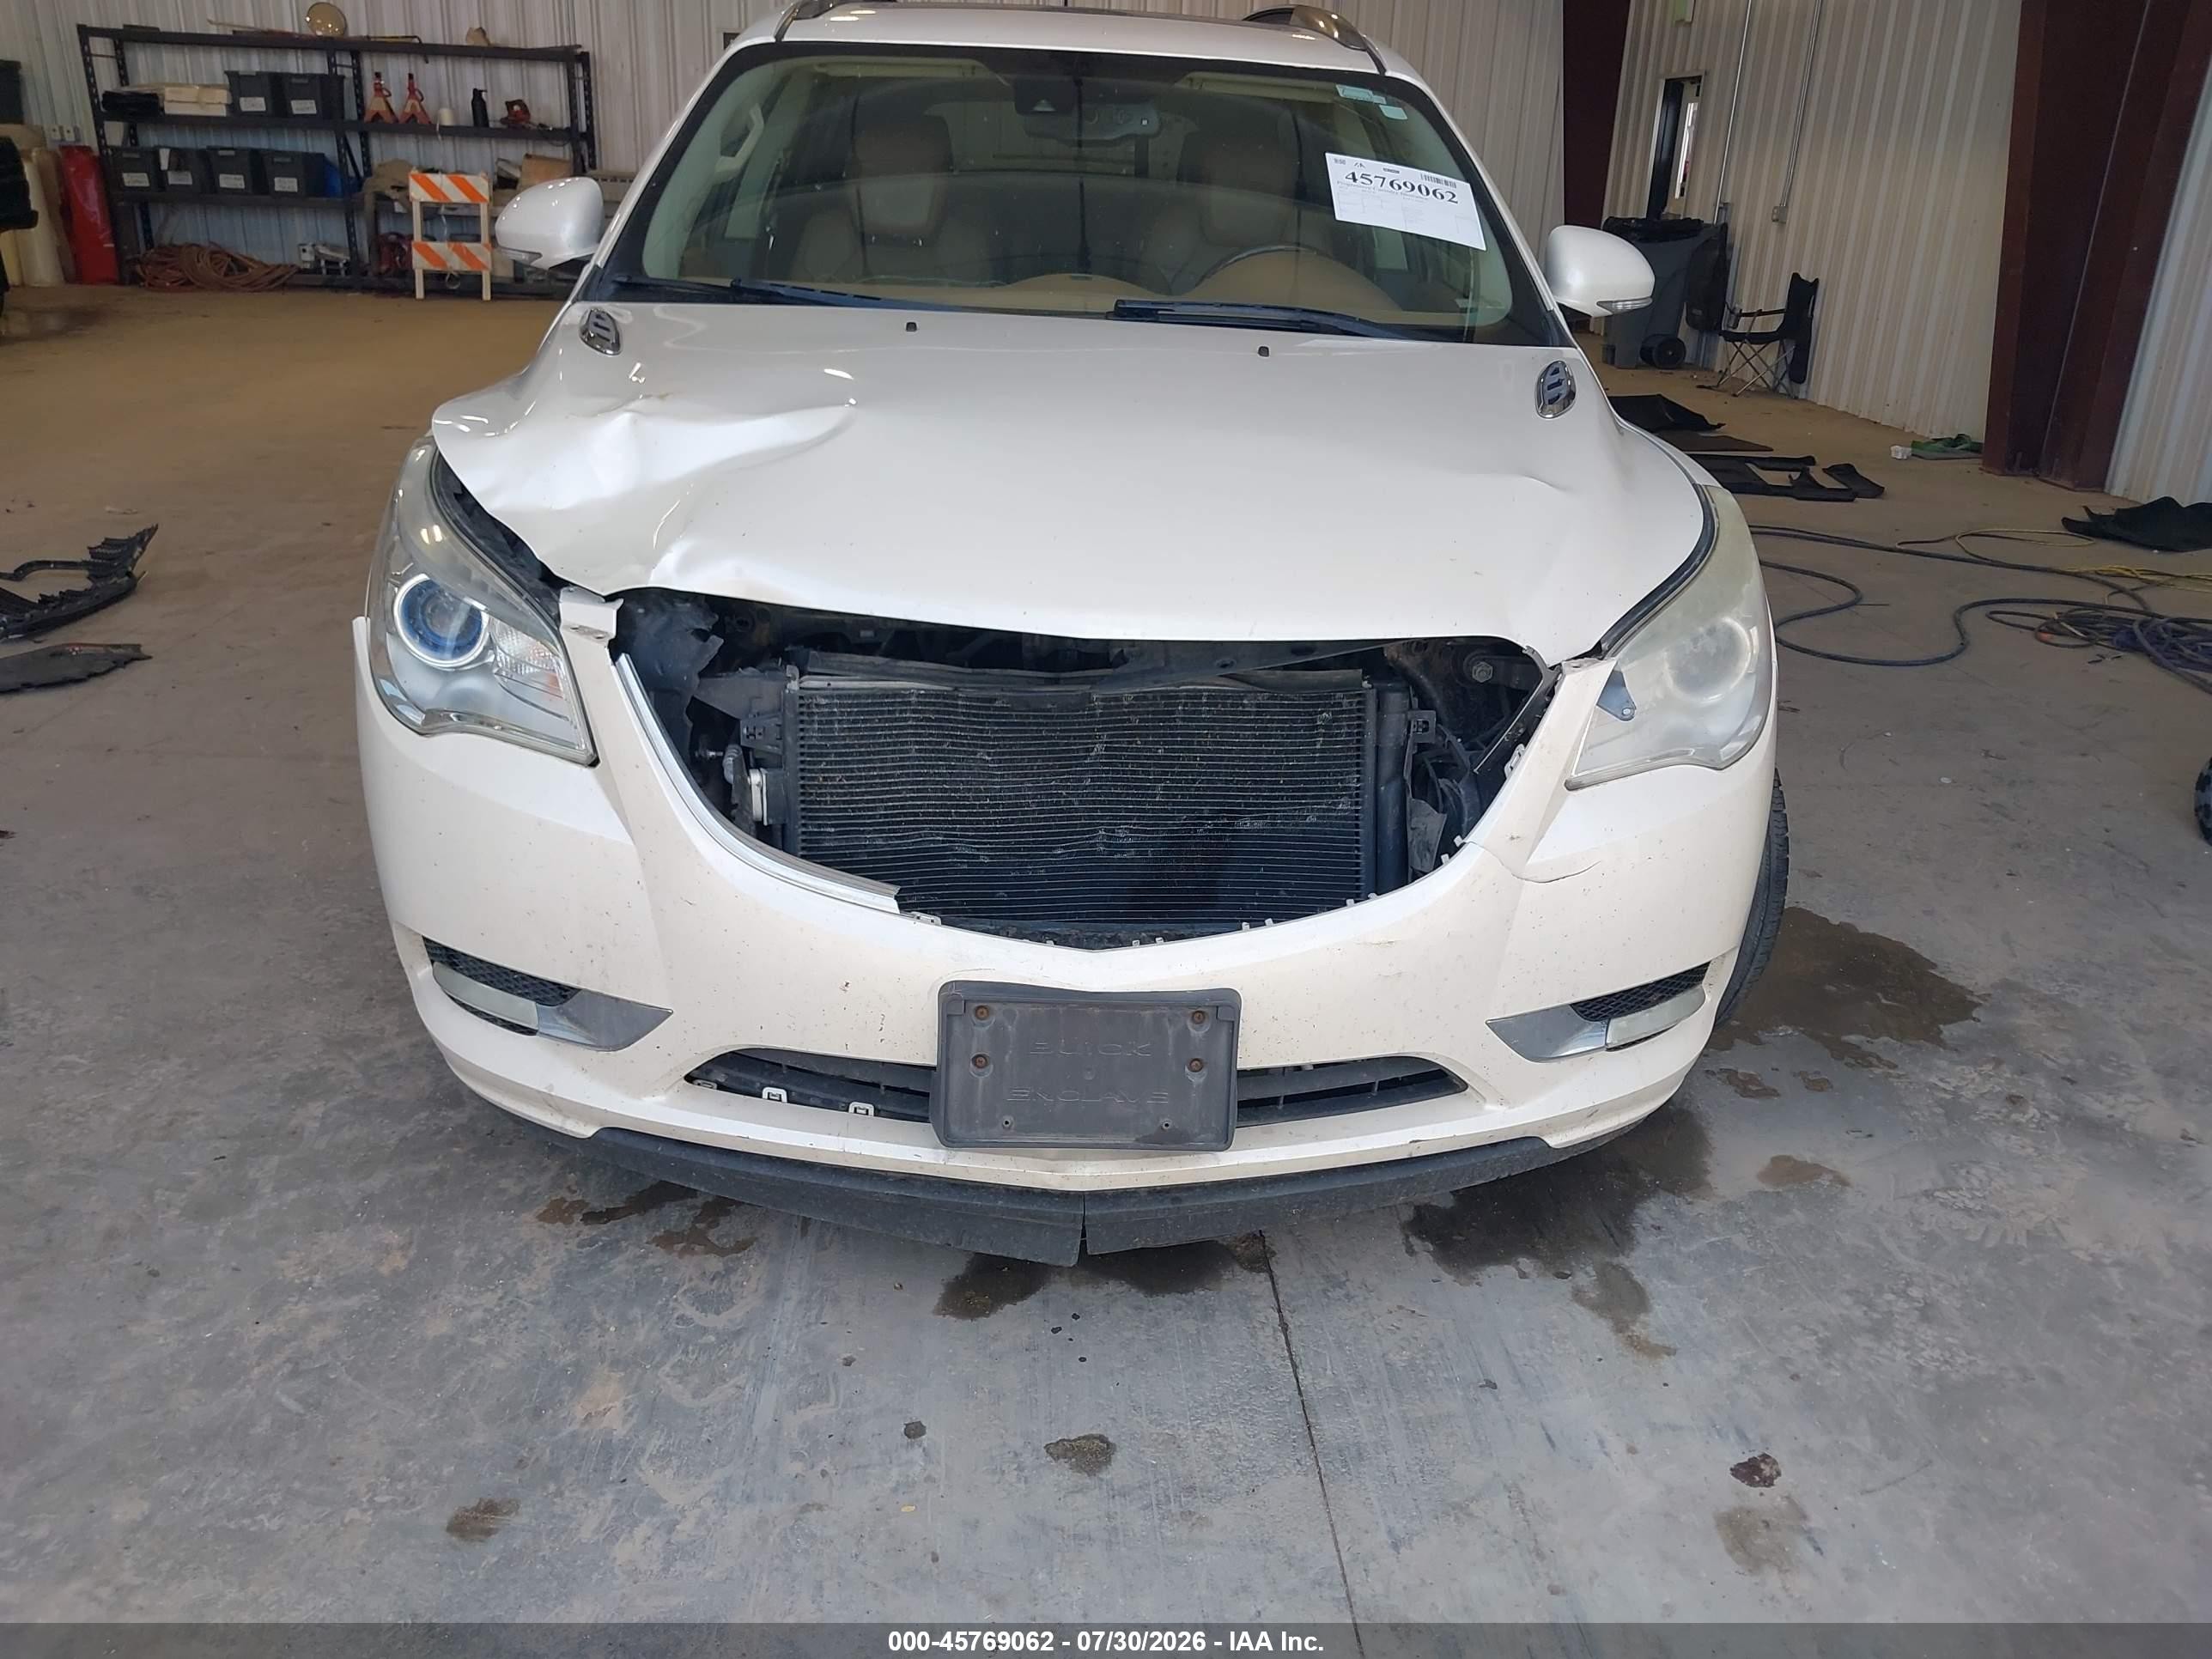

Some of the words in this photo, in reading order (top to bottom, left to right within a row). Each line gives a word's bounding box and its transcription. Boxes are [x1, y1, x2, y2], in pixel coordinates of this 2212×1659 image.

[1345, 171, 1458, 204] 45769062
[1030, 1042, 1152, 1056] BUICK
[1006, 1088, 1169, 1104] ENCLAVE
